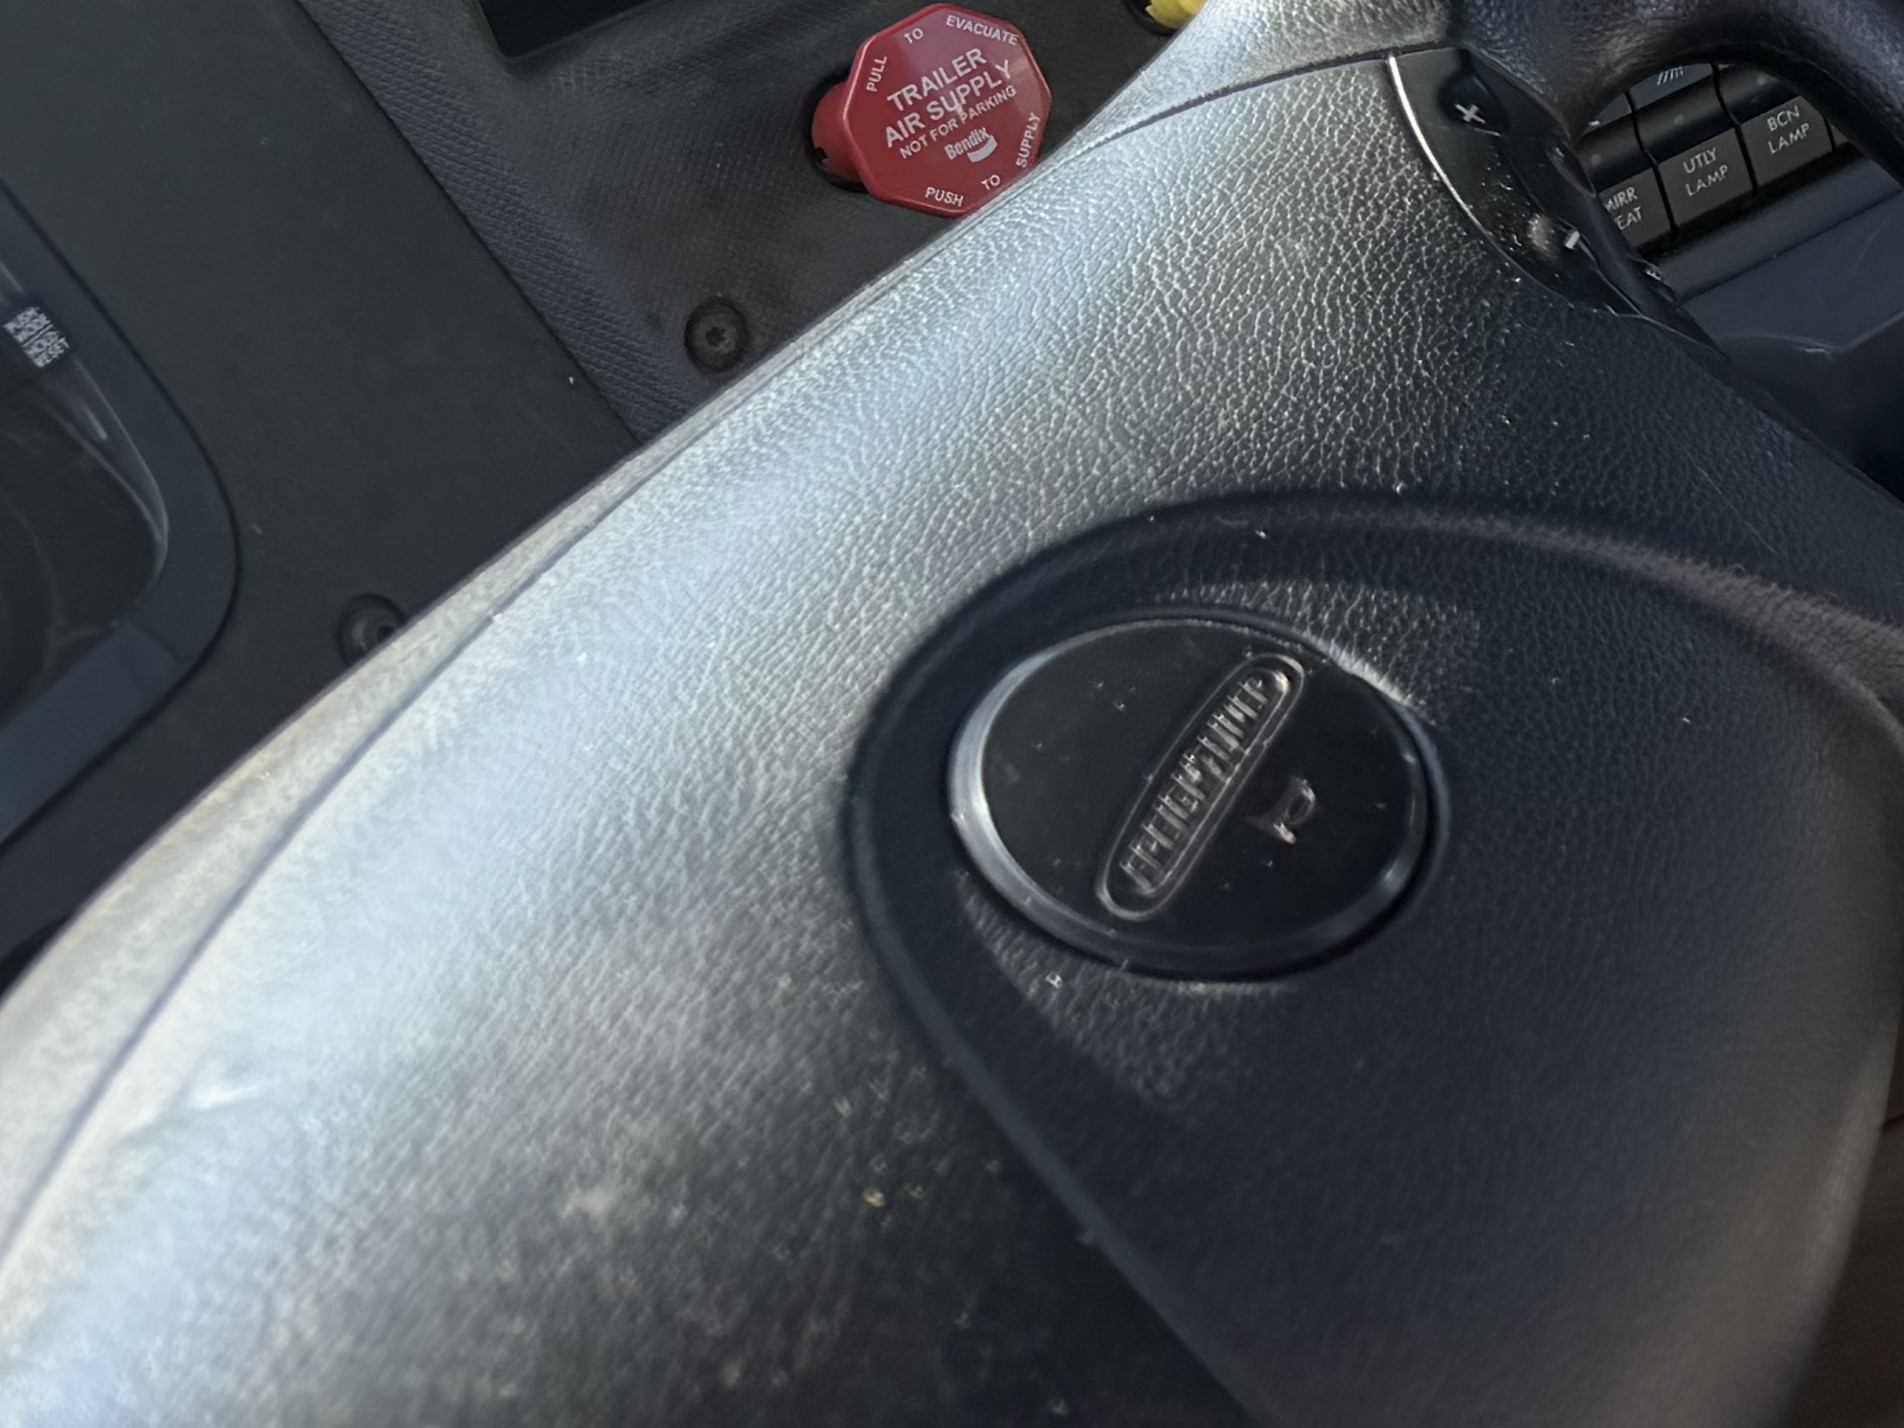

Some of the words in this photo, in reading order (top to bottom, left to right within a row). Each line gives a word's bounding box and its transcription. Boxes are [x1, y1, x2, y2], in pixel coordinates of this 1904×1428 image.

[866, 55, 888, 93] PULL
[903, 27, 924, 44] TO
[946, 14, 1020, 46] EVACUATE
[887, 47, 988, 112] TRAILER
[885, 112, 926, 149] AIR
[926, 59, 1012, 121] SUPPLY
[1767, 104, 1801, 133] BCN
[899, 137, 928, 160] NOT
[929, 118, 960, 142] FOR
[959, 84, 1018, 125] PARKING
[1767, 121, 1811, 156] LAMP
[924, 186, 965, 208] PUSH
[980, 173, 1002, 191] TO
[1015, 111, 1041, 169] SUPPLY
[944, 126, 991, 161] Bendix
[1683, 147, 1719, 175] UTLY
[1685, 164, 1731, 198] LAMP
[1613, 206, 1645, 231] EAT
